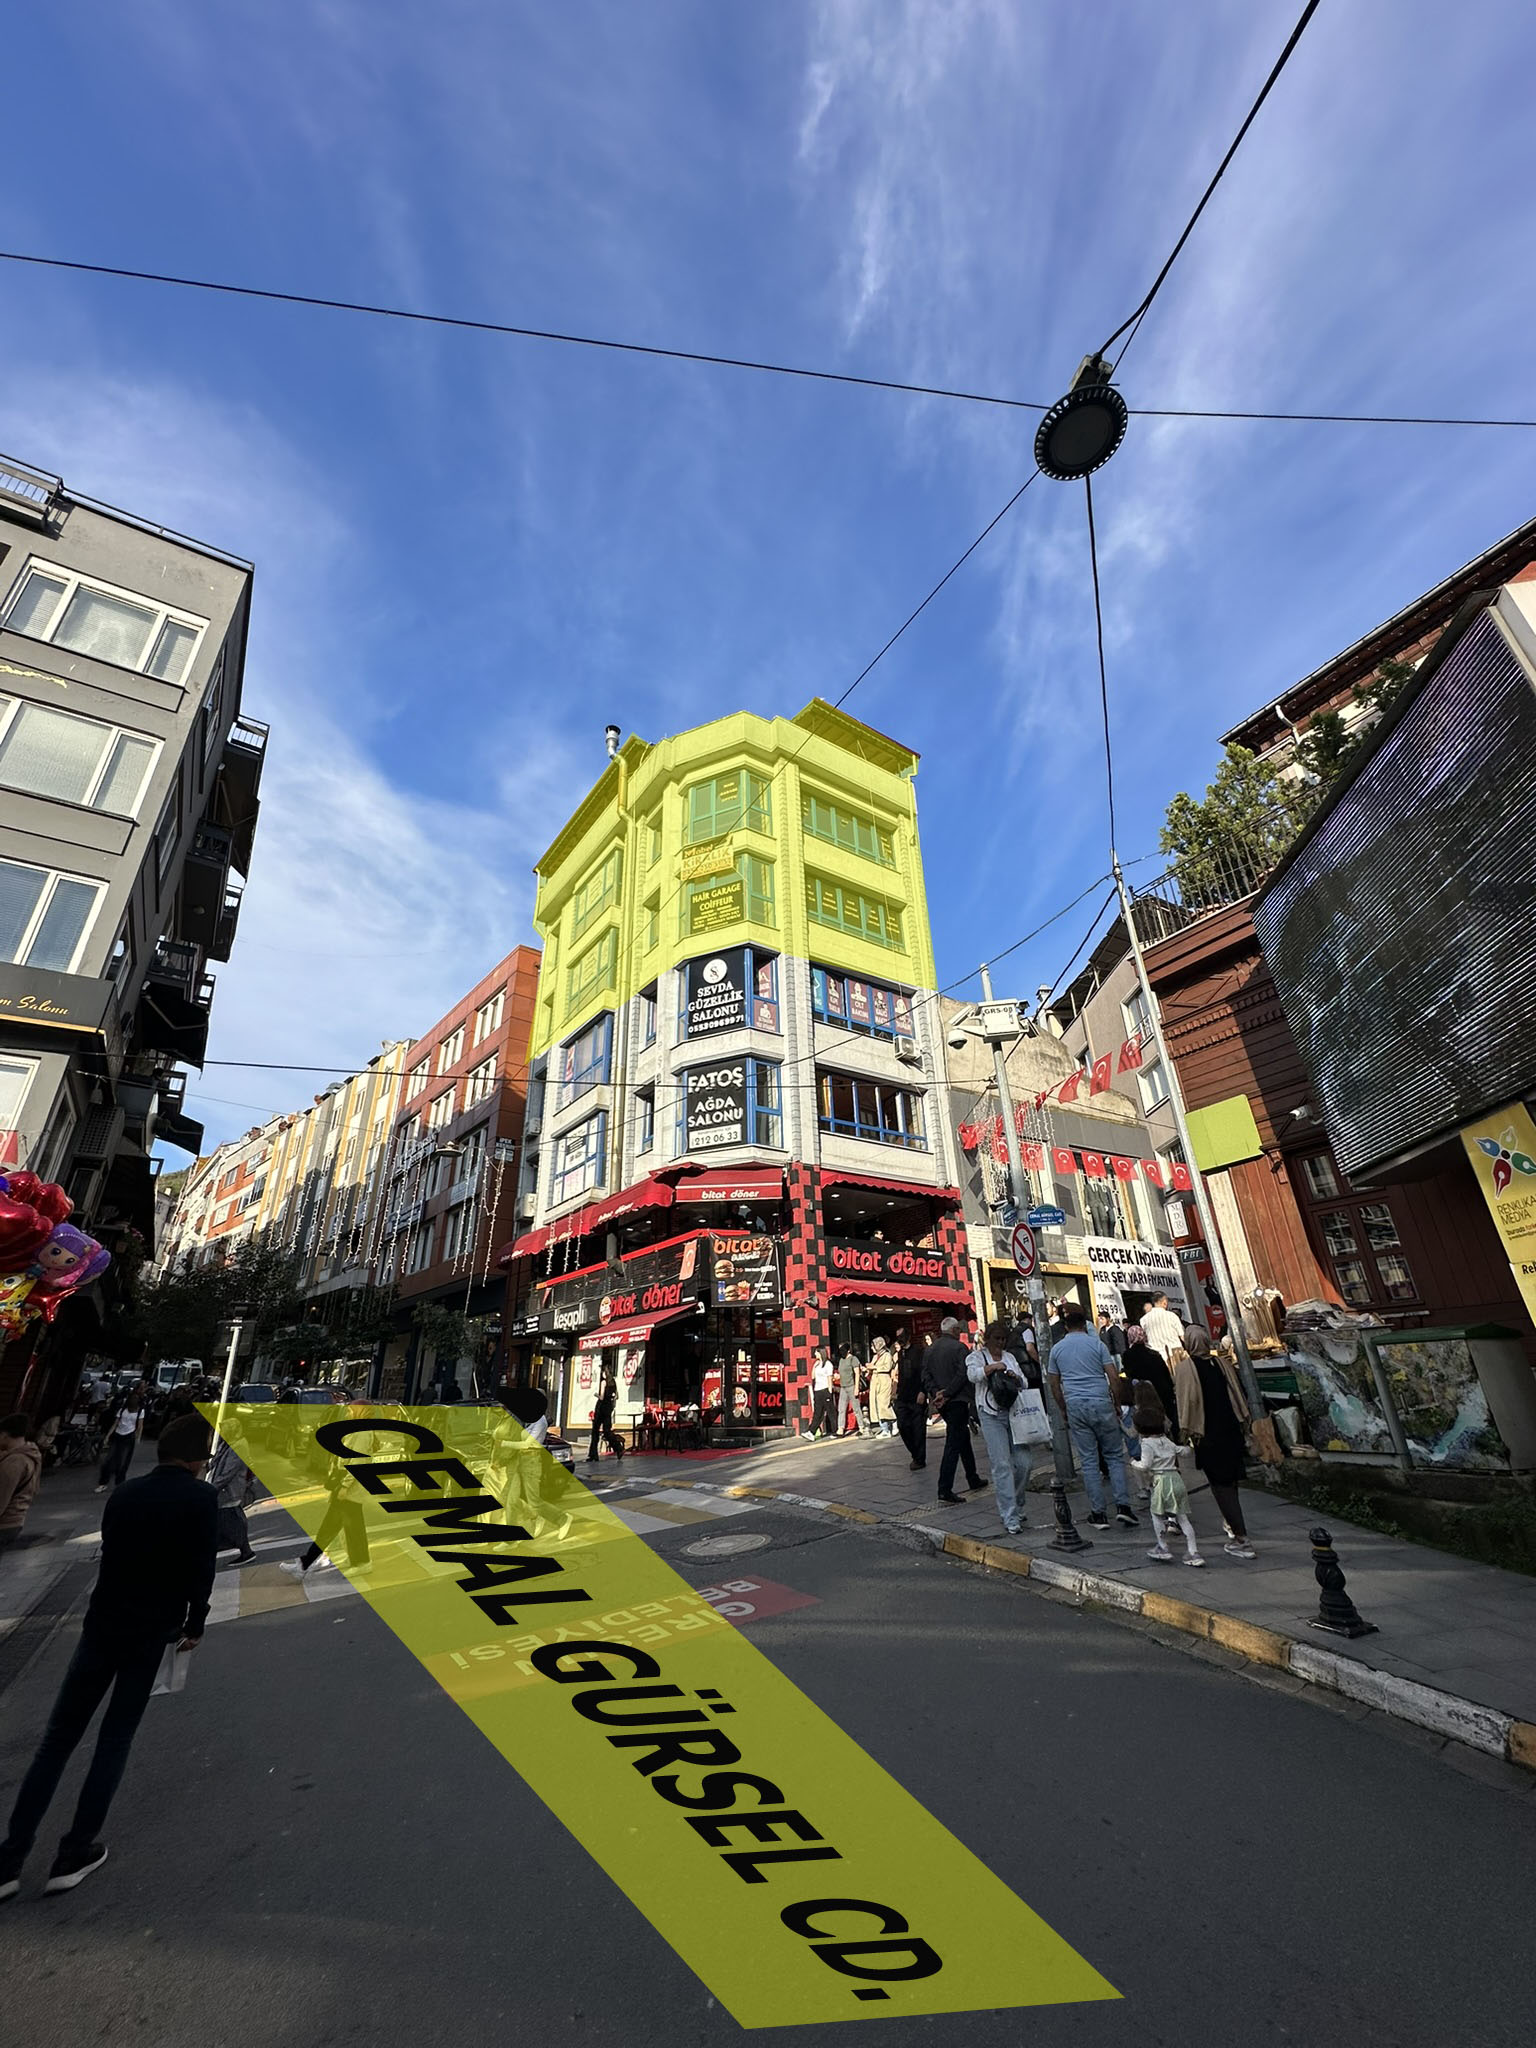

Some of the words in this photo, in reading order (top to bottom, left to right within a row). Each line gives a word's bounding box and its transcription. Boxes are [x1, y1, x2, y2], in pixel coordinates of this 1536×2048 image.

[711, 882, 741, 899] GARAGE
[697, 981, 734, 998] SEVDA
[17, 995, 69, 1015] Salonu
[688, 990, 744, 1012] GÜZELLİK
[692, 1003, 739, 1023] SALONU
[688, 1066, 744, 1094] FATOŞ
[695, 1096, 736, 1113] AĞDA
[688, 1107, 744, 1128] SALONU
[701, 1190, 726, 1199] bitat
[730, 1188, 760, 1198] döner
[1501, 1209, 1531, 1226] MEDYA
[714, 1237, 762, 1254] bitat
[832, 1246, 882, 1273] bitat
[888, 1250, 946, 1278] döner
[1088, 1246, 1134, 1269] GERÇEK
[1133, 1245, 1175, 1270] İNDİRİM
[1092, 1270, 1110, 1283] HER
[1111, 1271, 1127, 1287] ŞEY
[1129, 1271, 1148, 1287] YARI
[609, 1292, 638, 1318] bitat
[641, 1281, 683, 1310] döner
